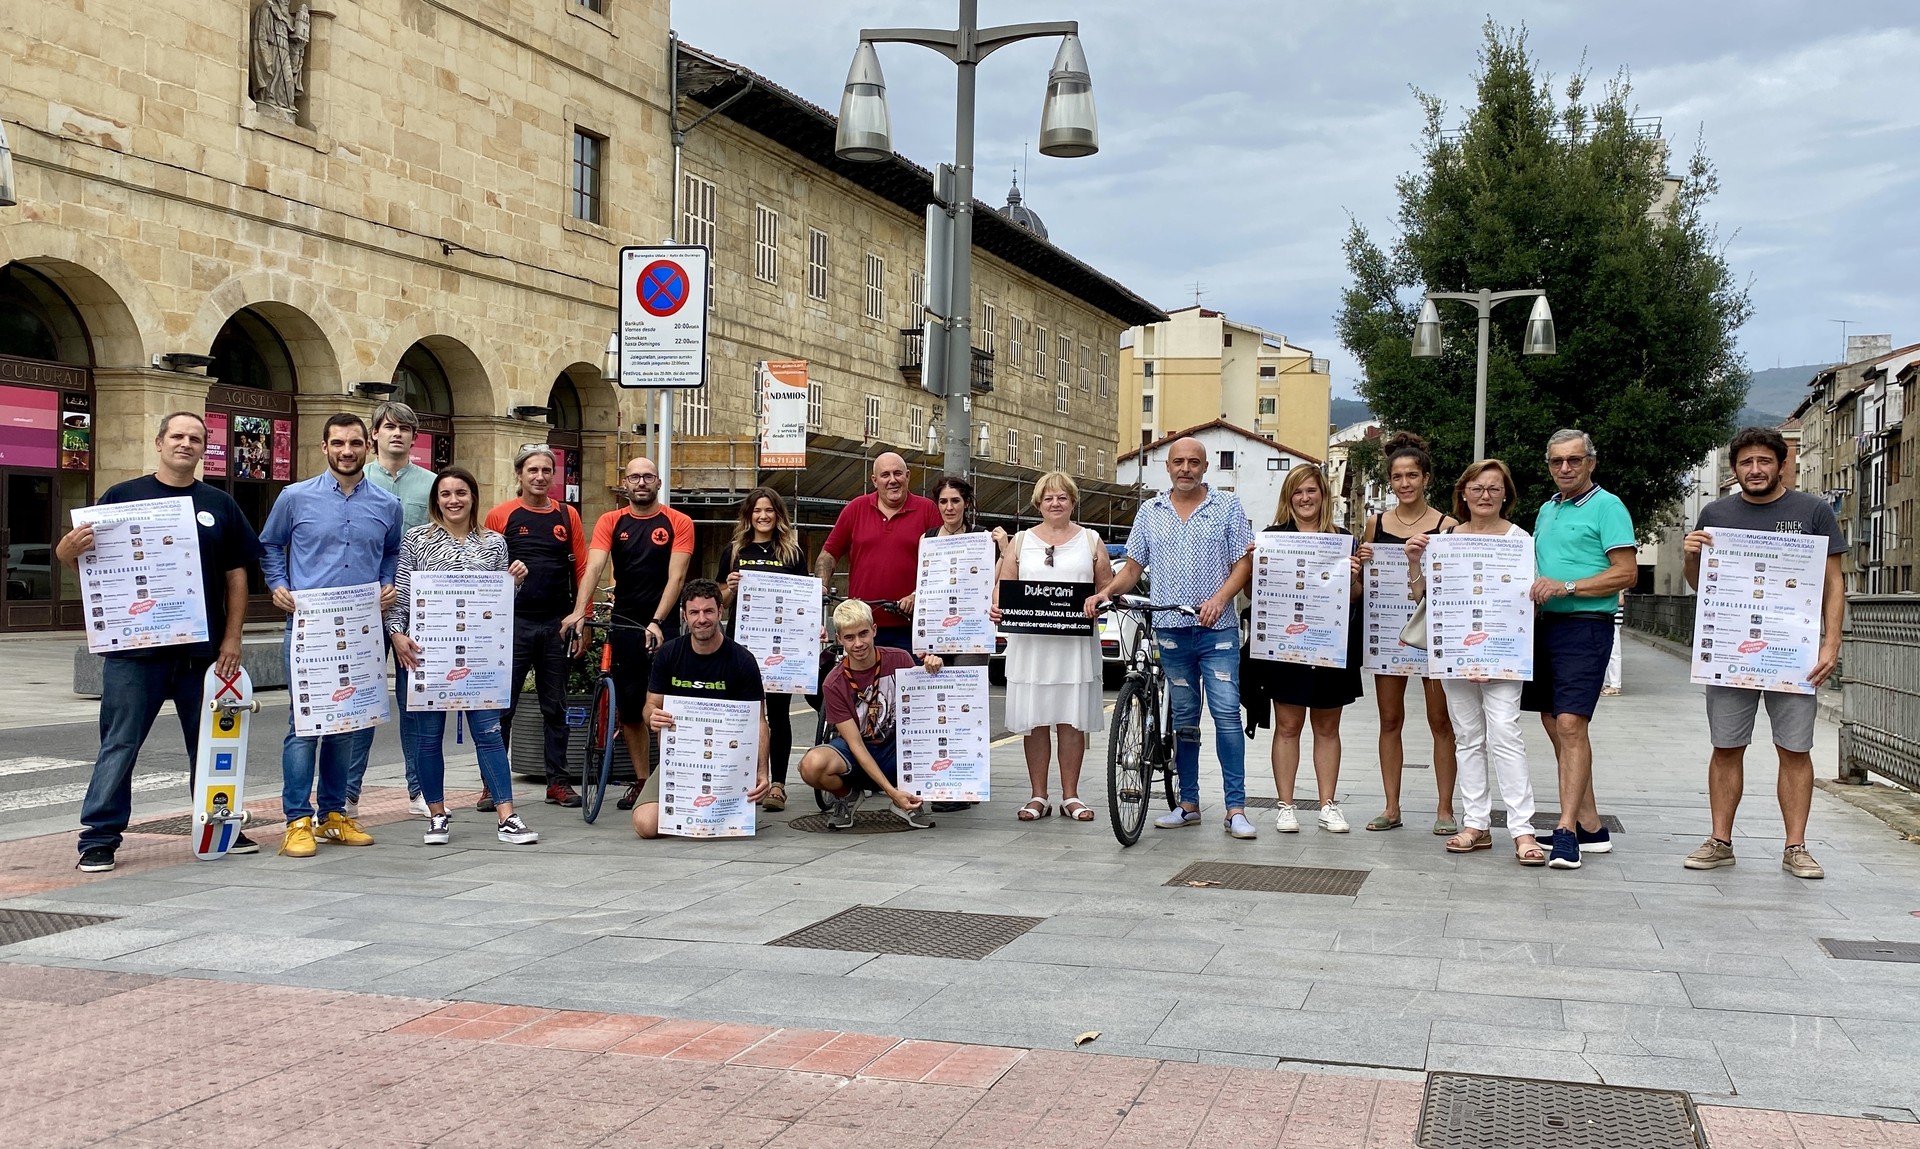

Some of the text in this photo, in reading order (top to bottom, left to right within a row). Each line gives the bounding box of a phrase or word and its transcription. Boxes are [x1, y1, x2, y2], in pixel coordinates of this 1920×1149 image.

[2, 363, 82, 385] CULTURAL
[225, 392, 278, 407] AGUSTIN
[1776, 521, 1802, 530] ZEINEK
[1716, 532, 1815, 544] EUROPAKOMUGIKORTASUNASTEA
[1729, 538, 1815, 549] SEMANAEUROPEADELAMOVILIDAD
[1025, 584, 1073, 597] Dukerami
[135, 624, 170, 632] DURANGO
[1740, 666, 1778, 675] DURANGO
[672, 677, 726, 690] basati
[337, 709, 367, 718] DURANGO
